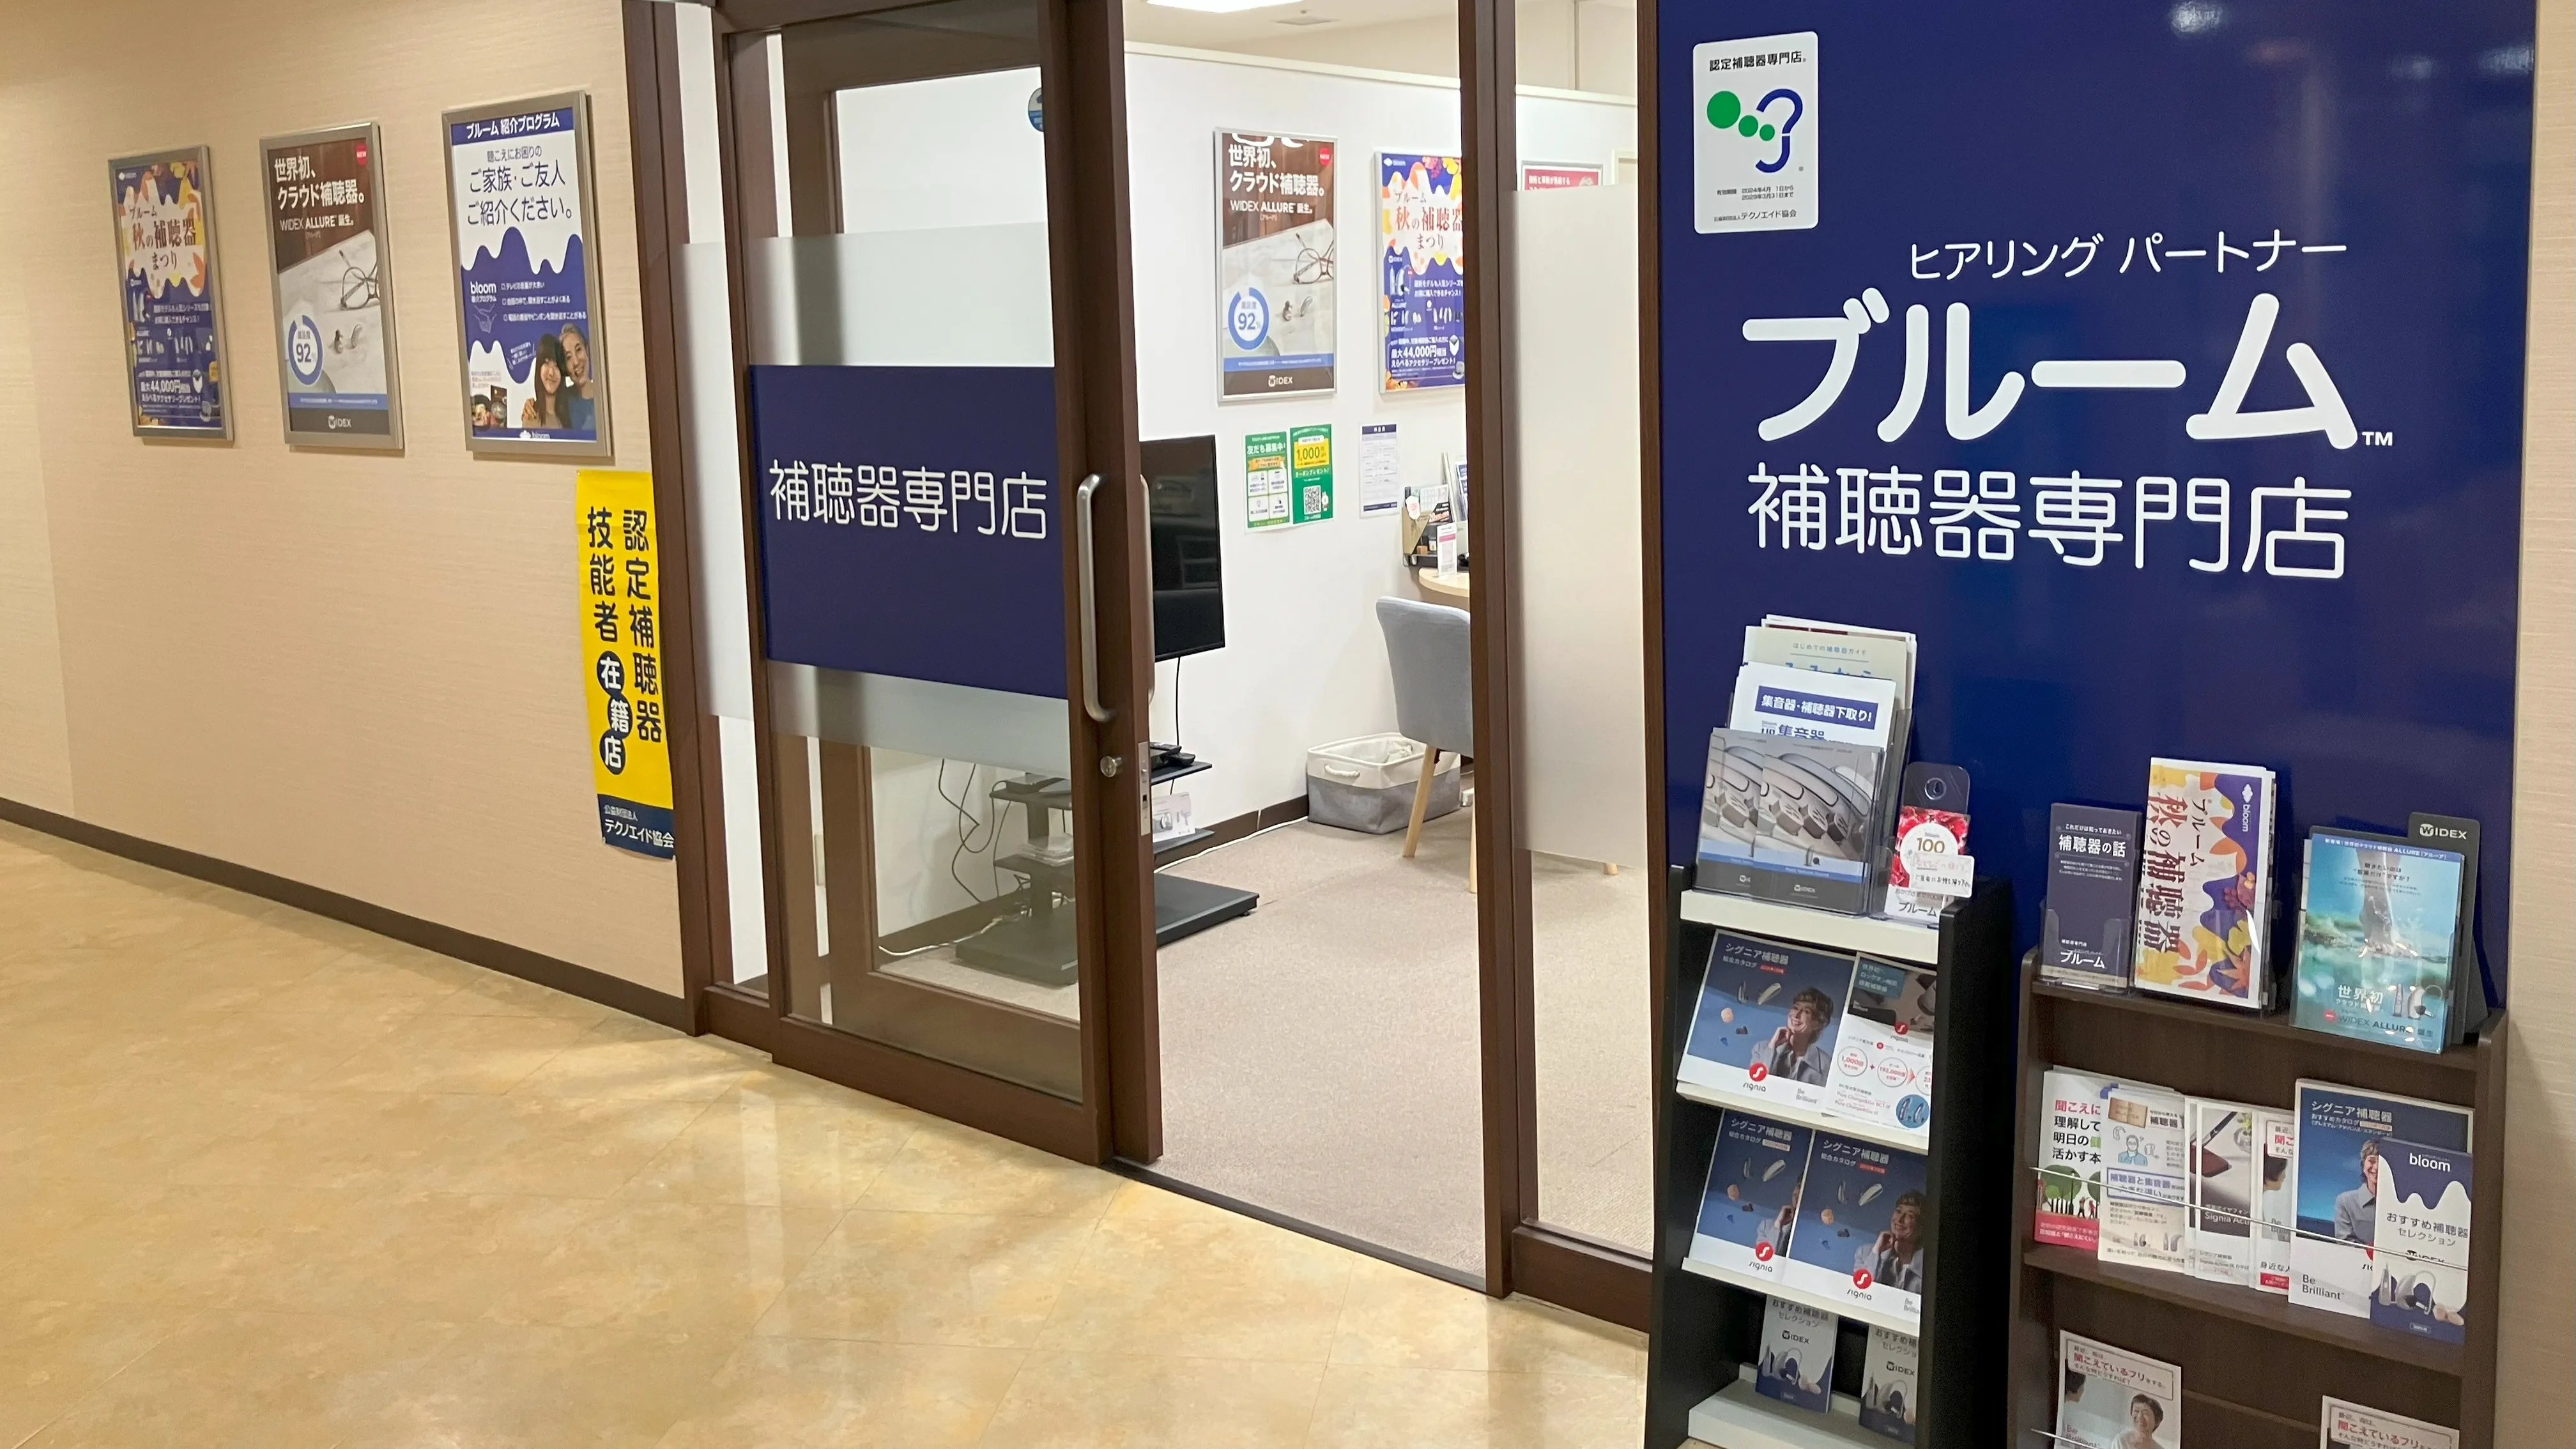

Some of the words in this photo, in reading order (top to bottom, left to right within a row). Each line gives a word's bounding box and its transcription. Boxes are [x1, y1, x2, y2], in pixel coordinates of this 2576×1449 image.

[466, 120, 499, 139] ブルーム
[500, 112, 560, 135] 紹介プログラム
[487, 145, 542, 163] 聴こえにお困りの
[1229, 144, 1276, 169] 世界初、
[275, 155, 316, 183] 世界初、
[470, 159, 565, 193] ご家族・ご友人
[277, 179, 365, 211] クラウド補聴器。
[1229, 170, 1324, 197] クラウド補聴器。
[1230, 200, 1259, 211] WIDEX
[1395, 192, 1427, 203] ブルーム
[130, 205, 158, 220] ブルーム
[468, 195, 572, 226] ご紹介ください。
[1396, 206, 1462, 232] 秋の補聴器
[132, 218, 197, 251] 秋の補聴器
[279, 217, 304, 231] WIDEX
[1417, 233, 1444, 250] まつり
[152, 250, 178, 271] まつり
[1910, 231, 2104, 280] ヒアリング
[2119, 228, 2347, 273] パートナー
[470, 281, 497, 295] bloom
[1742, 287, 2358, 450] ブルーム
[1268, 375, 1293, 387] WIDEX
[328, 415, 352, 429] WIDEX
[769, 459, 1048, 540] 補聴器専門店
[1747, 461, 2353, 580] 補聴器専門店
[587, 505, 620, 643] 技能者
[622, 508, 662, 744] 認定補聴器
[599, 655, 631, 769] 在籍店
[1760, 694, 1872, 723] 集音器・補聴器下取り!
[2241, 803, 2251, 832] bloom
[604, 818, 675, 848] テクノエイド協会
[2190, 798, 2212, 867] ブルーム
[2419, 823, 2467, 840] WIDEX
[1916, 838, 1945, 854] 100
[2058, 834, 2126, 858] 補聴器の話
[2143, 790, 2189, 953] 秋の補聴器
[1898, 901, 1937, 917] ブルーム
[1725, 942, 1789, 965] シグニア補聴器
[2060, 951, 2105, 969] ブルーム
[2338, 985, 2383, 1004] 世界初
[2339, 1015, 2370, 1026] WIDEX
[2311, 1100, 2392, 1123] シグニア補聴器
[1731, 1118, 1793, 1142] シグニア補聴器
[2054, 1116, 2101, 1132] 理解して
[1823, 1139, 1889, 1165] シグニア補聴器
[2052, 1147, 2101, 1165] 活かす本
[2409, 1153, 2451, 1173] bloom
[2204, 1211, 2231, 1223] Signia
[2386, 1213, 2469, 1239] おすすめ補聴器
[2397, 1227, 2457, 1247] セレクション
[1749, 1261, 1773, 1273] signia
[2302, 1274, 2316, 1285] Be
[1847, 1289, 1872, 1301] signia
[1782, 1330, 1810, 1344] WIDEX
[1886, 1361, 1915, 1377] WIDEX
